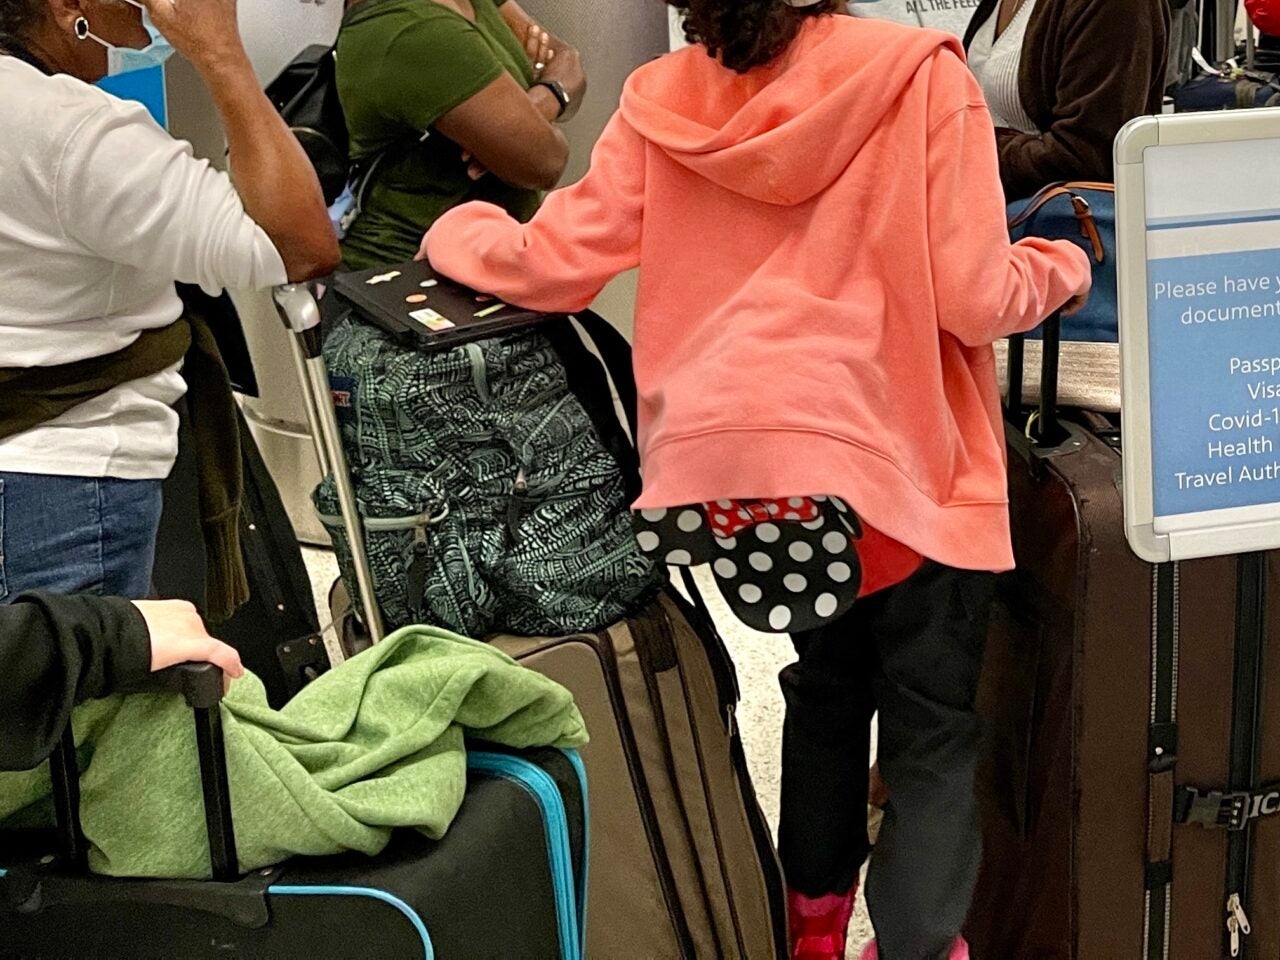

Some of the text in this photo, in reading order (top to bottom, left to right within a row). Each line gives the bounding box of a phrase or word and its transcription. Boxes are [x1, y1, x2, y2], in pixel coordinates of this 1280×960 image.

[1154, 280, 1217, 300] Please
[1224, 275, 1270, 293] have
[1208, 436, 1273, 459] Health
[1174, 466, 1233, 490] Travel
